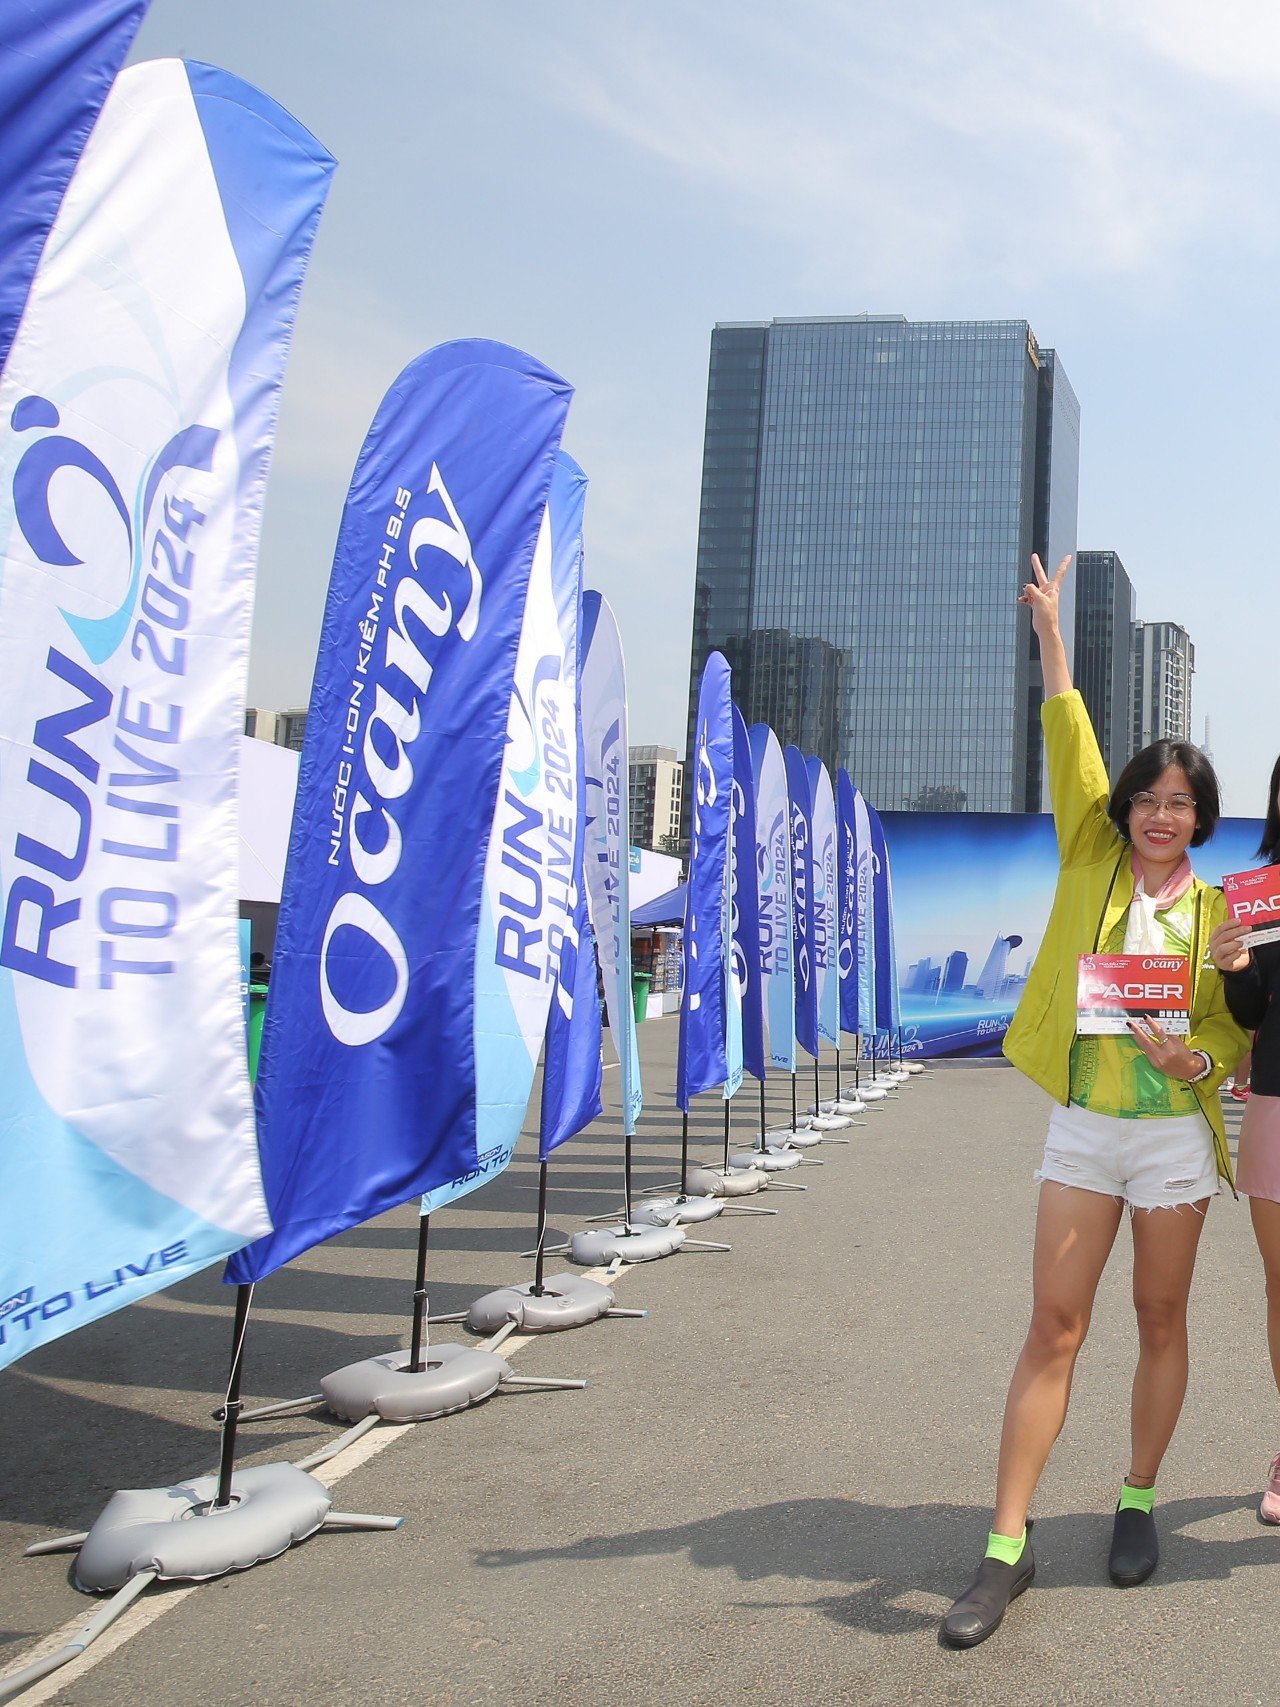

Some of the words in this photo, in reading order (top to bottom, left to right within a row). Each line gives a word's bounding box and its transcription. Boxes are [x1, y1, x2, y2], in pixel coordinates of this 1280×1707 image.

[131, 494, 208, 677] 2024
[328, 761, 353, 866] NƯỚC
[343, 680, 365, 755] I-ON
[376, 543, 396, 588] PH
[386, 486, 412, 540] 9.5
[101, 684, 183, 863] LIVE
[320, 461, 483, 1046] Ocany
[541, 698, 573, 802] 2024
[3, 645, 115, 989] RUN
[607, 756, 620, 837] 2024
[495, 789, 543, 980] RUN
[548, 808, 573, 912] LIVE
[775, 834, 786, 885] 2024
[826, 852, 835, 896] 2024
[858, 866, 868, 903] 2024
[98, 887, 179, 991] TO
[759, 894, 774, 975] RUN
[775, 892, 788, 940] LIVE
[814, 902, 827, 970] RUN
[826, 899, 836, 944] LIVE
[775, 947, 789, 976] TO
[827, 946, 836, 970] TO
[1086, 983, 1184, 1000] PACER
[1142, 958, 1184, 972] Ocany
[978, 1019, 998, 1029] RUN
[12, 1291, 74, 1330] TO
[84, 1239, 189, 1300] LIVE
